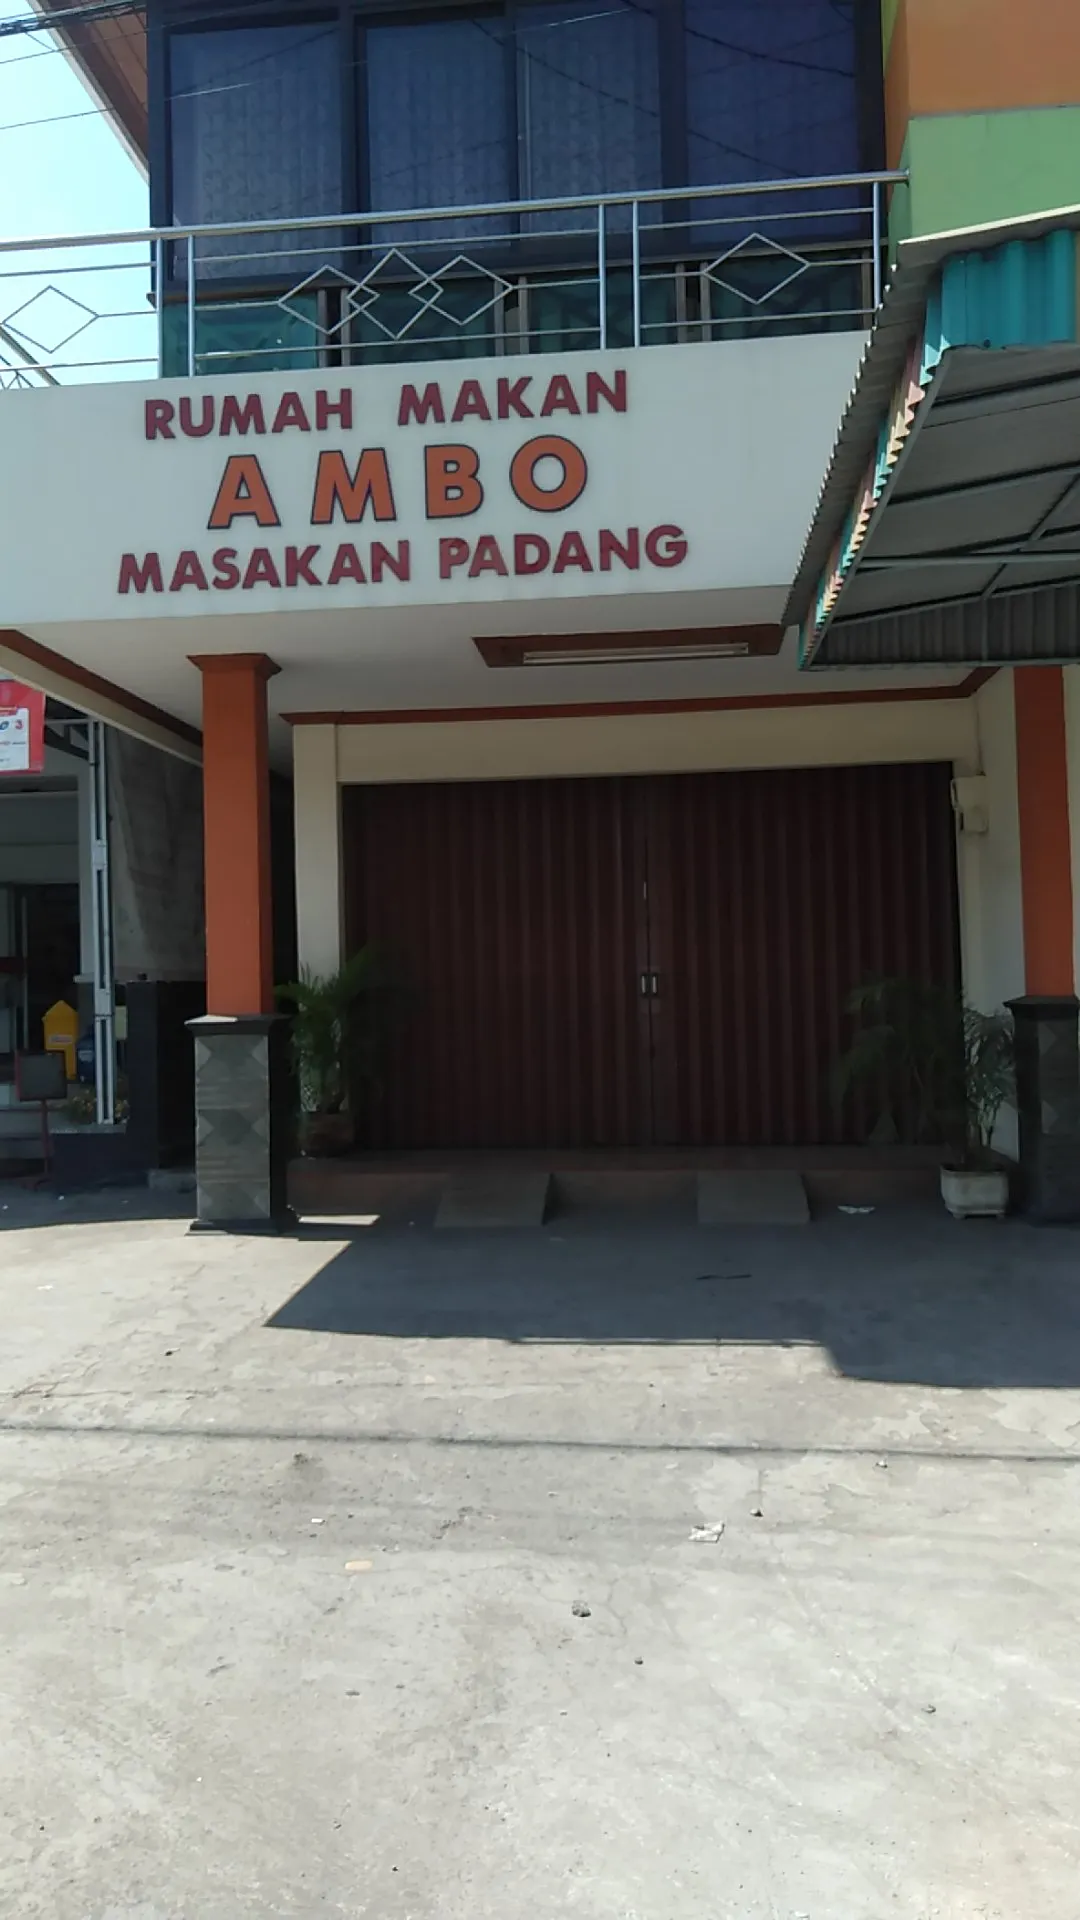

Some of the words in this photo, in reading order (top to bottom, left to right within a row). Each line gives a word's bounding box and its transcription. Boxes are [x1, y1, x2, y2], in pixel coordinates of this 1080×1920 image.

[145, 388, 353, 440] RUMAH
[398, 370, 628, 426] MAKAN
[207, 434, 589, 530] AMBO
[118, 540, 411, 594] MASAKAN
[439, 525, 689, 580] PADANG
